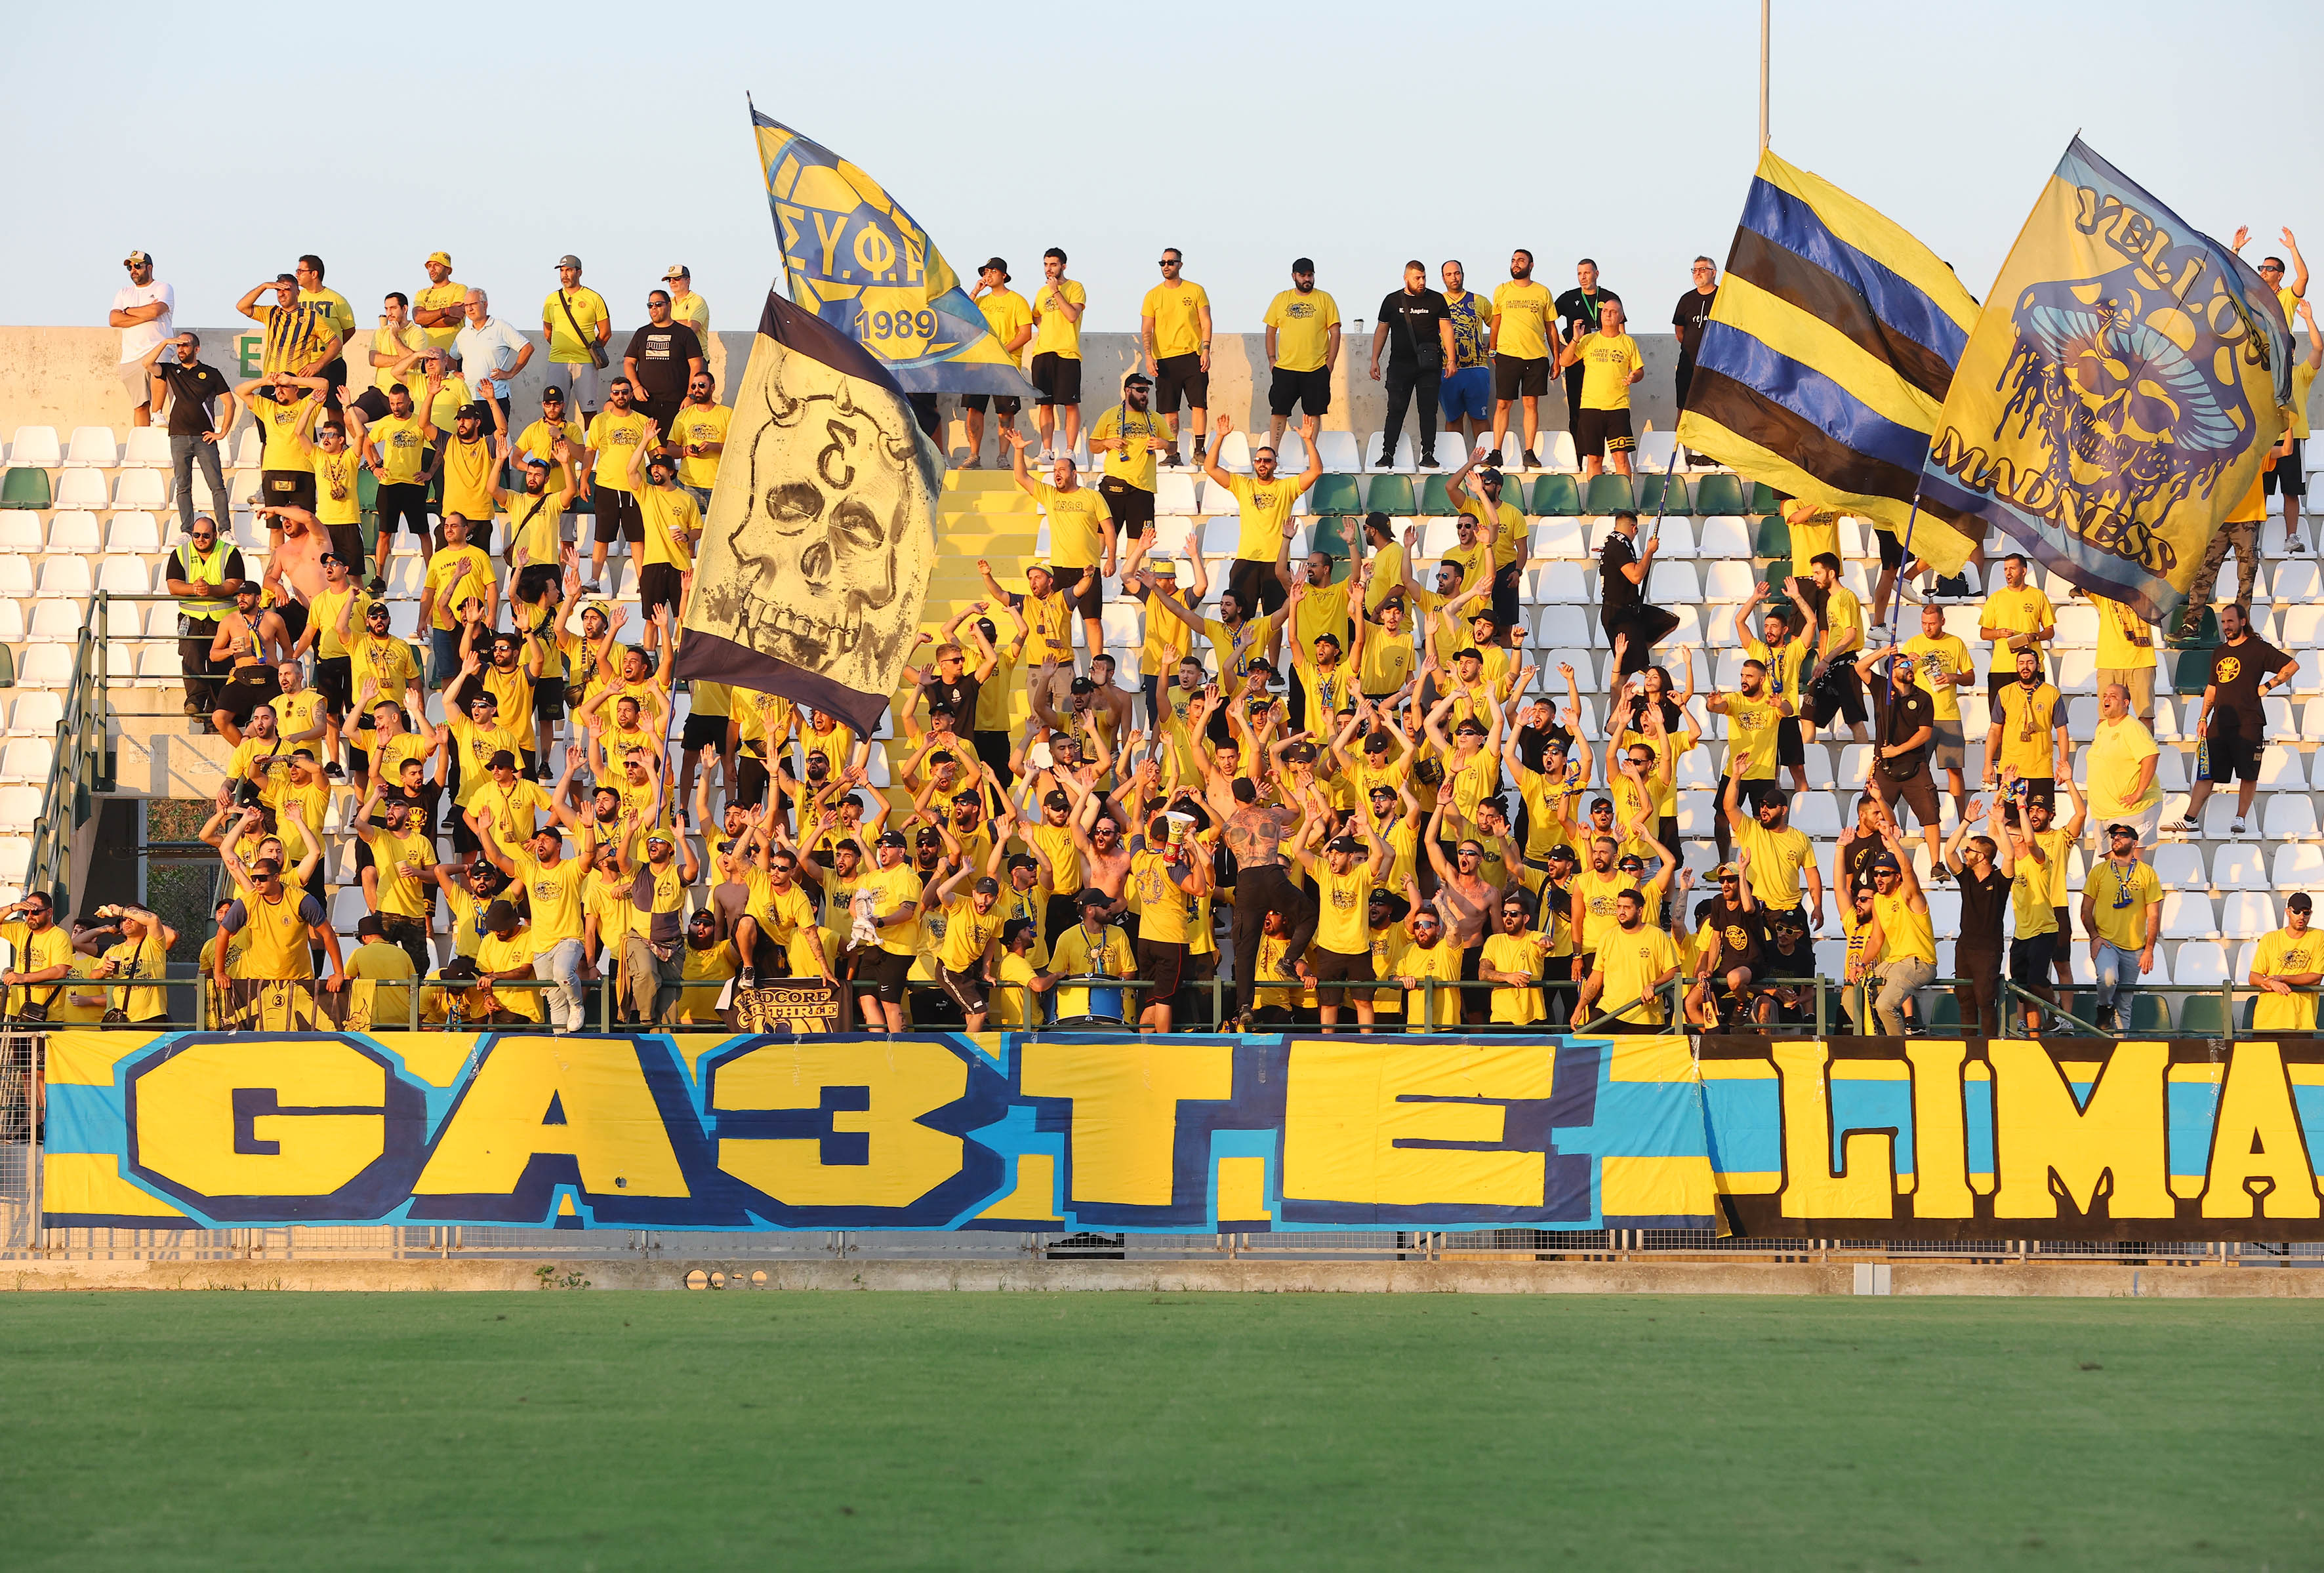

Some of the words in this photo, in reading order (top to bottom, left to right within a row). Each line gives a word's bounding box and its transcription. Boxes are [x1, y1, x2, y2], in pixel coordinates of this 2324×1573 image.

[775, 201, 924, 282] ΣΥ.Φ.Α
[855, 310, 938, 340] 1989
[1692, 300, 1708, 329] rela
[240, 337, 262, 378] E
[1932, 425, 2178, 580] MADNESS
[441, 561, 459, 570] LIMA
[272, 995, 283, 1006] 3
[768, 1004, 838, 1018] THREE
[1771, 1040, 2322, 1219] LIMA
